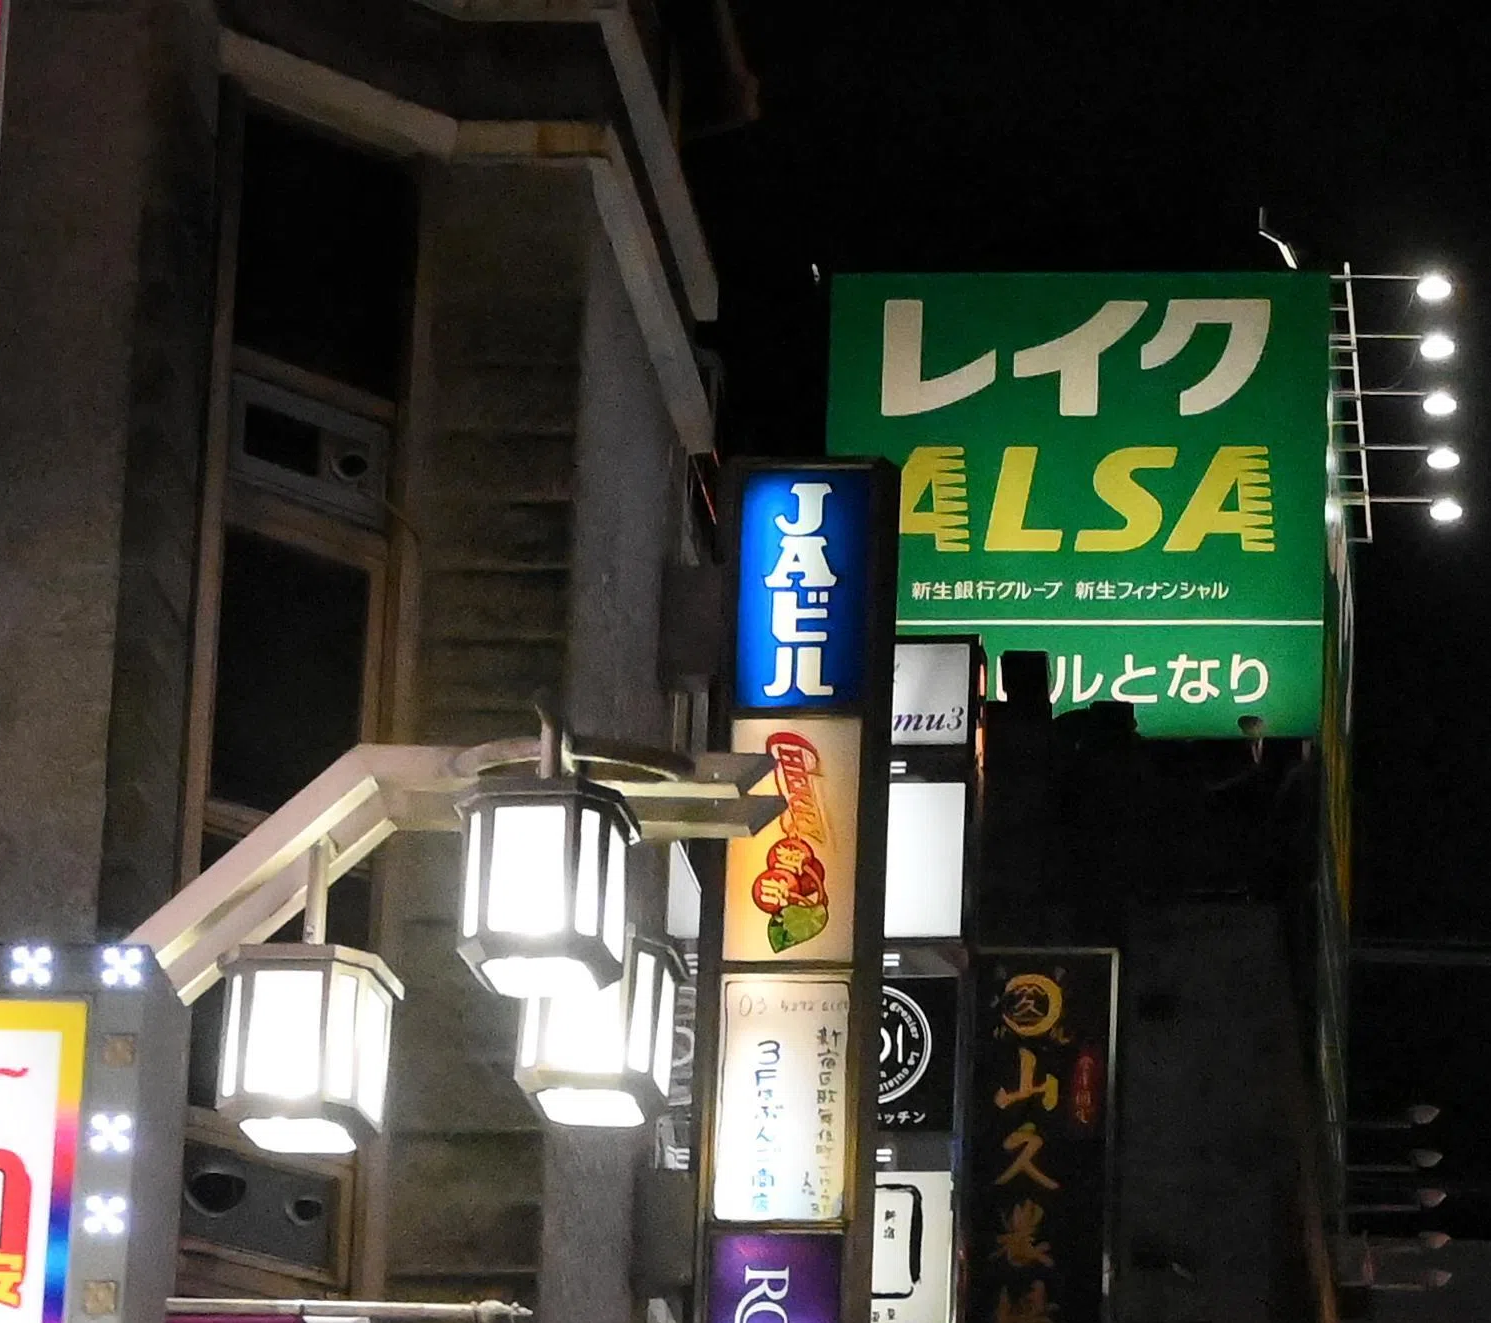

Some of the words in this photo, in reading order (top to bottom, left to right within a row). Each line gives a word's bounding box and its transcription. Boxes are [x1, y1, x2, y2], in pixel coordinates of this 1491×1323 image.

[881, 299, 1271, 417] レイク
[763, 482, 837, 697] JAビル
[911, 581, 1063, 601] 新生銀行グループ
[1075, 581, 1229, 600] 新生フィナンシャル
